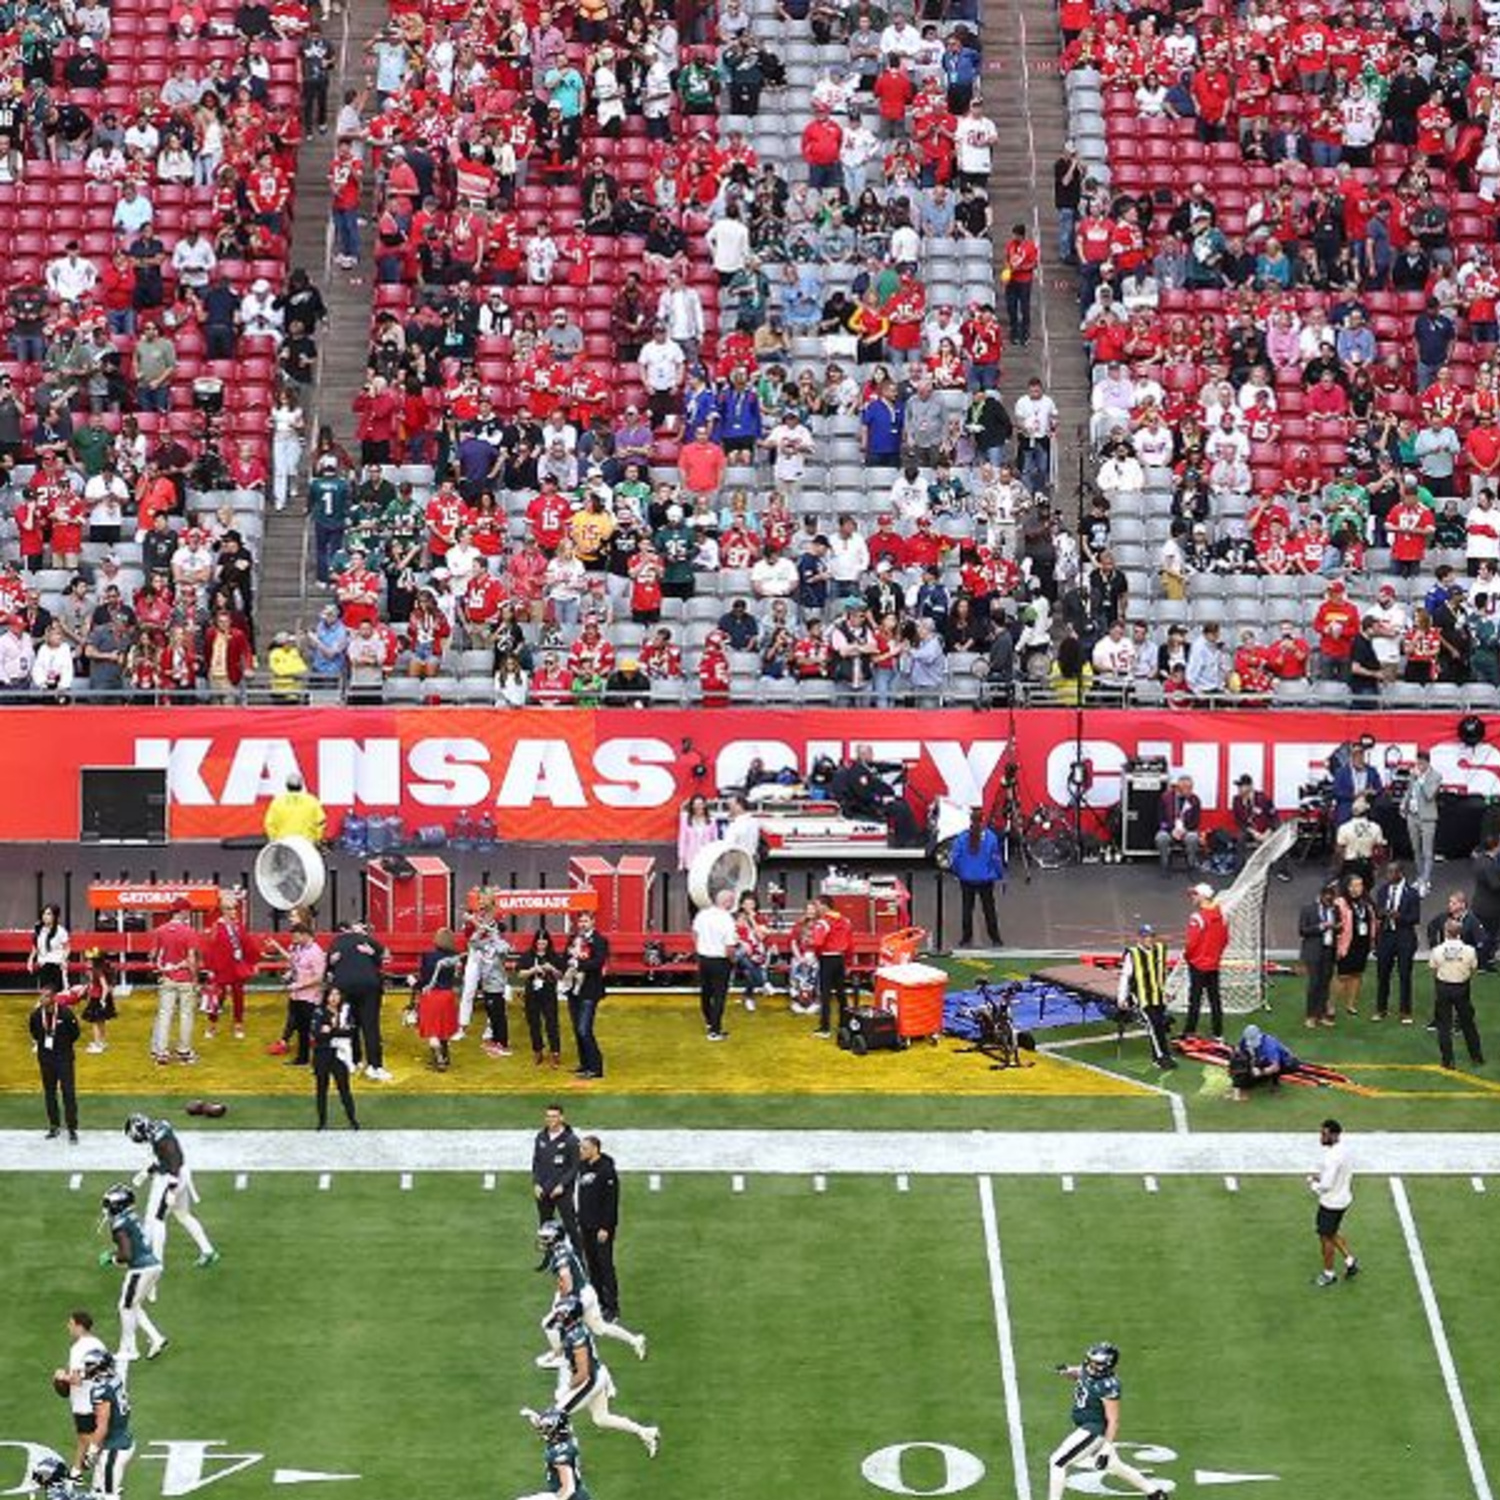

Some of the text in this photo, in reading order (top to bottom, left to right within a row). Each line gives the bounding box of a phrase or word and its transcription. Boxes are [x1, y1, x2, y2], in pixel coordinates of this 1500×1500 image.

[510, 126, 527, 144] 15
[1250, 421, 1270, 440] 15
[320, 492, 333, 516] 1
[442, 505, 462, 526] 15
[545, 509, 561, 530] 15
[1110, 653, 1128, 673] 15
[134, 738, 676, 808] KANSAS
